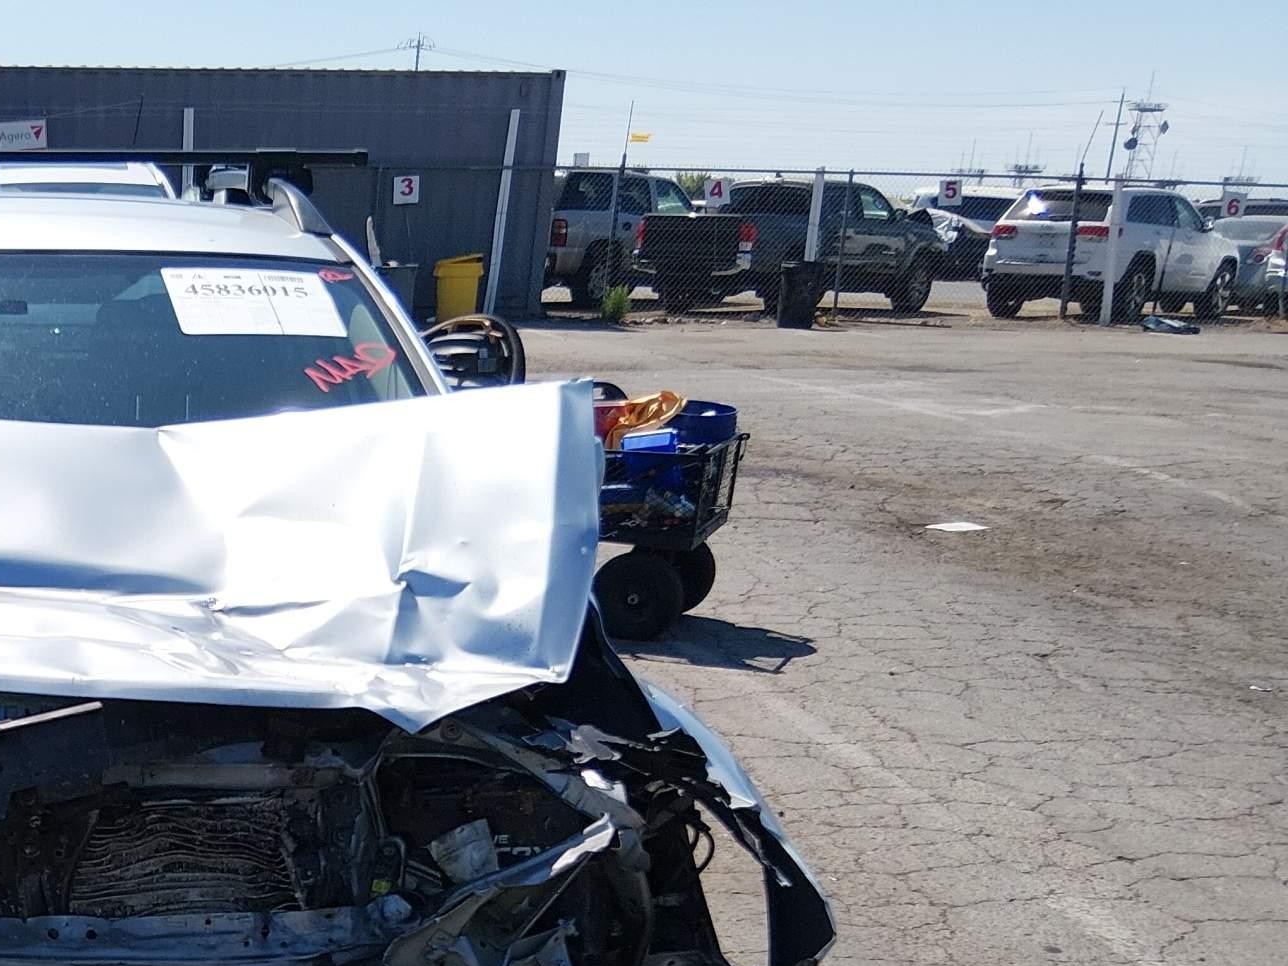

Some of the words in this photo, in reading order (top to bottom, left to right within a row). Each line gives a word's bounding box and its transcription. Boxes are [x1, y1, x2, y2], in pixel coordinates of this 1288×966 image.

[399, 177, 414, 196] 3
[709, 180, 723, 198] 4
[944, 180, 958, 199] 5
[1227, 198, 1241, 216] 6
[184, 283, 309, 298] 45836015
